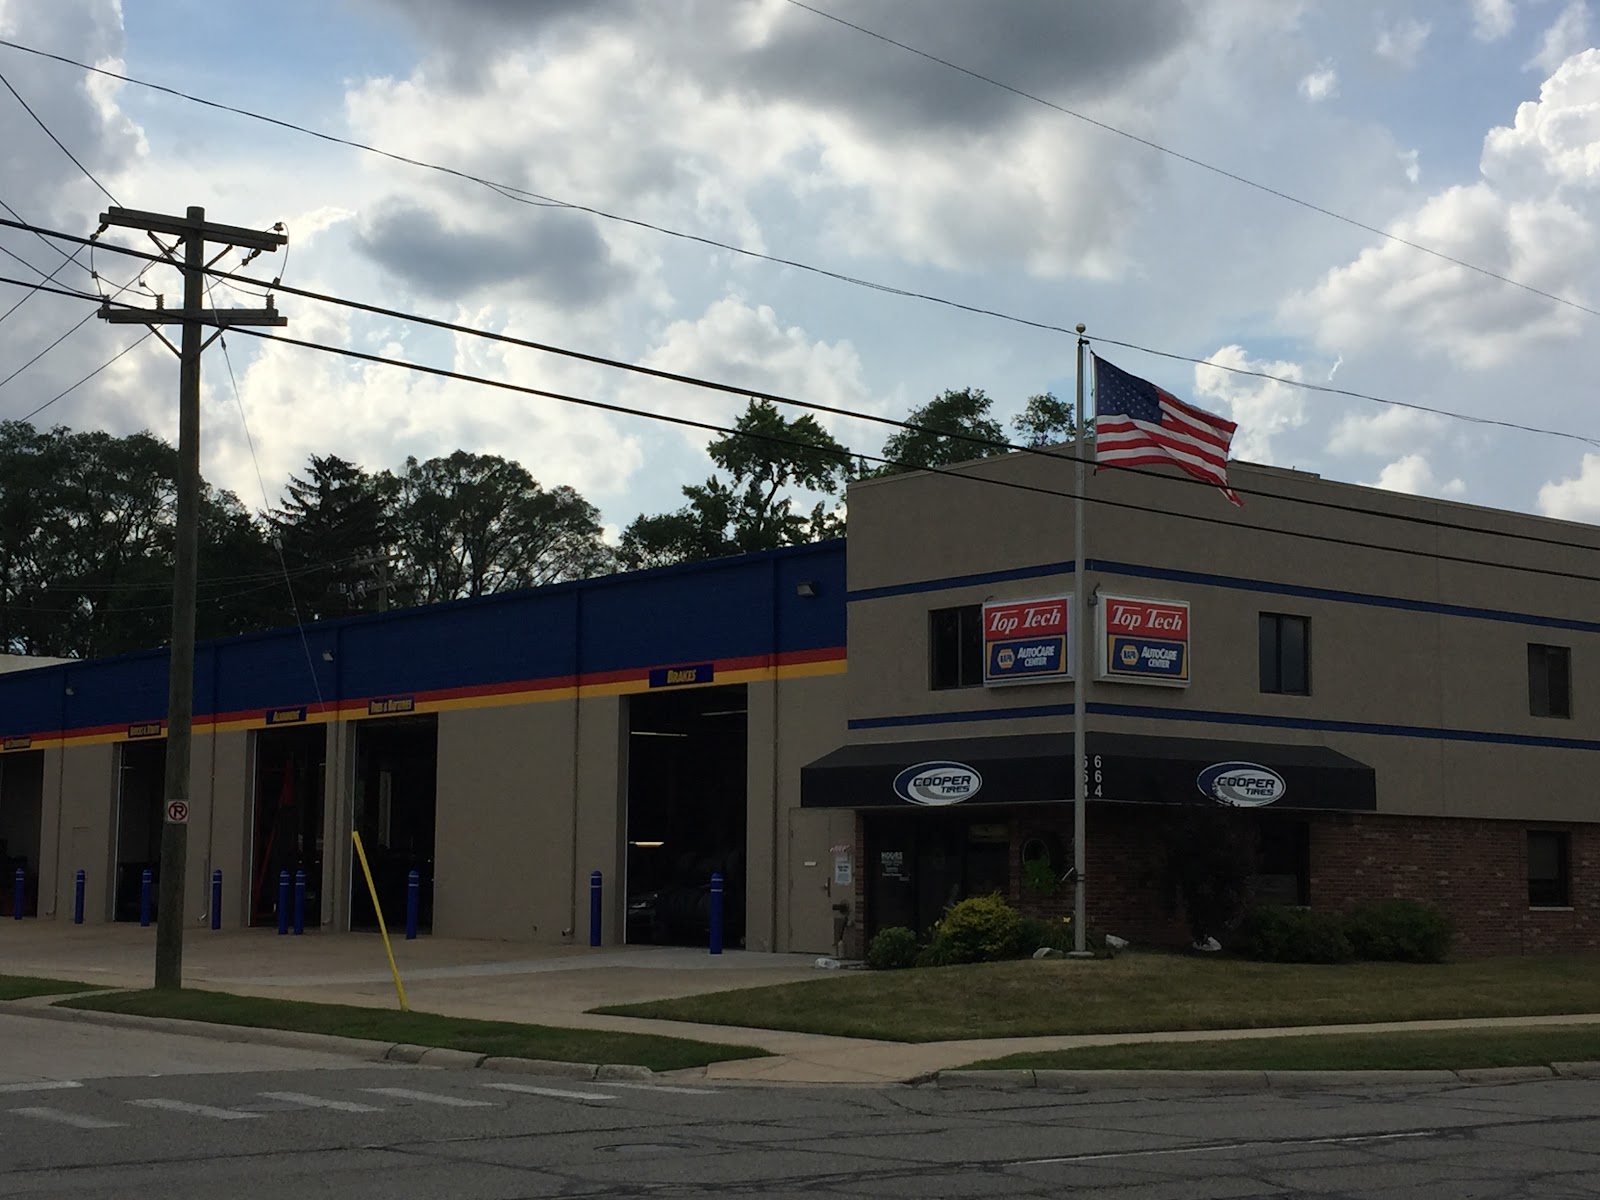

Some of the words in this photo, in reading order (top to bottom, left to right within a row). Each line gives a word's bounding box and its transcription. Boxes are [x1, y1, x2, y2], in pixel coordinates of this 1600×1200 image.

[989, 609, 1019, 635] Top
[1022, 605, 1062, 628] Tech
[1111, 605, 1142, 631] Top
[1145, 608, 1183, 631] Tech
[1024, 657, 1047, 667] CENTER
[1148, 658, 1171, 669] CENTER
[913, 775, 971, 787] COOPER
[1217, 777, 1275, 788] COOPER
[941, 785, 970, 793] TIRES
[1245, 788, 1274, 796] TIRES
